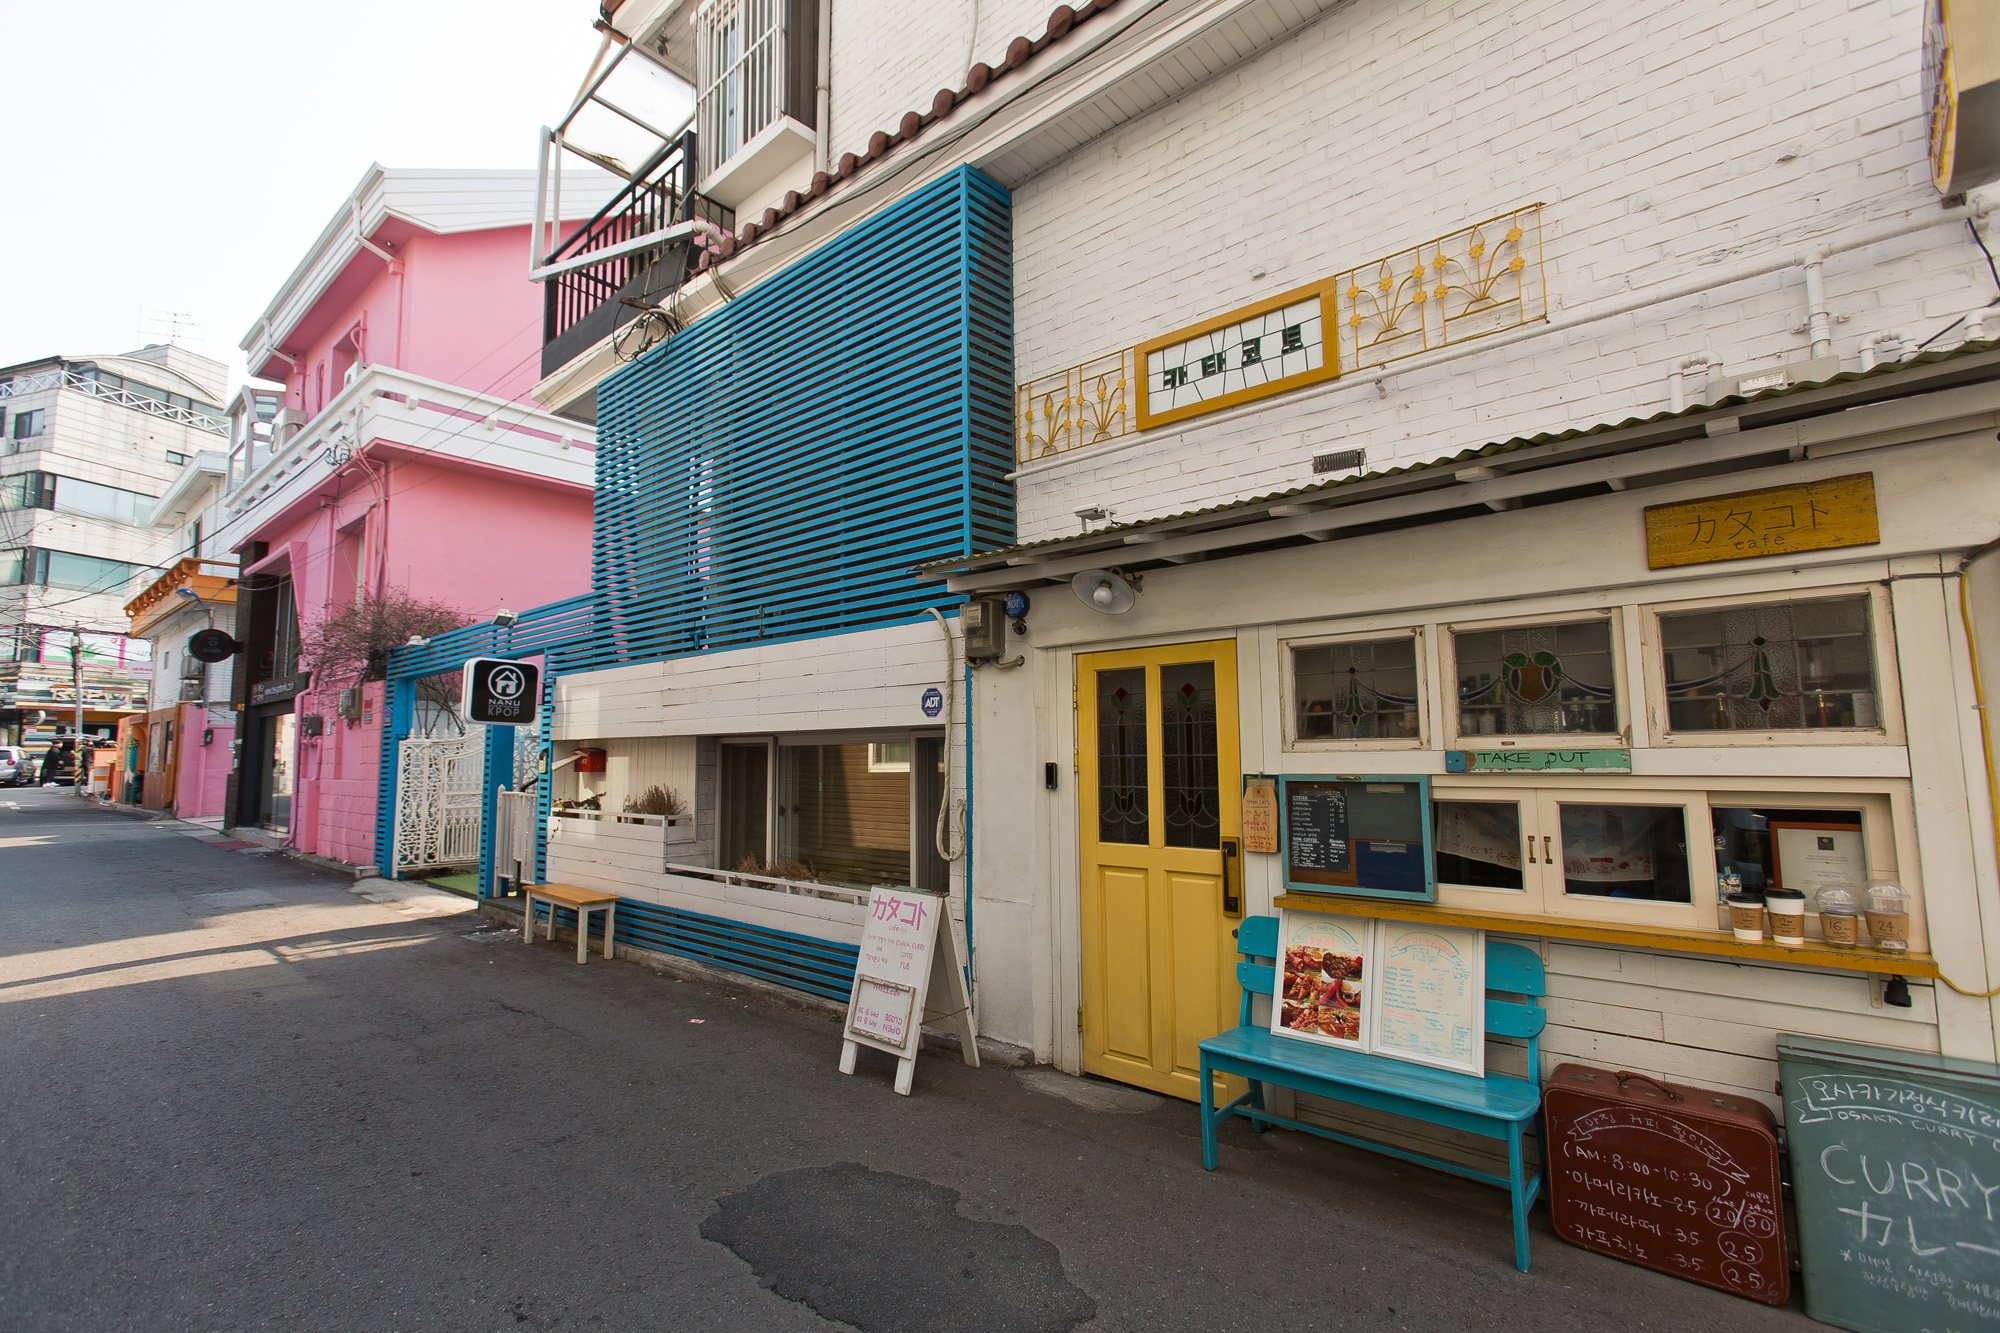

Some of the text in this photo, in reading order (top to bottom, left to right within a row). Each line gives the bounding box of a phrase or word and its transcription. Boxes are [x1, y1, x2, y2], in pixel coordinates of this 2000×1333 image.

[1687, 499, 1829, 545] カタコト
[1735, 533, 1785, 550] cafe
[925, 697, 939, 708] ADT
[488, 707, 520, 716] KPOP
[1477, 751, 1590, 763] TAKE OUT
[872, 894, 927, 931] カタコト
[888, 924, 899, 932] cafe
[1830, 921, 1842, 930] 16
[1878, 920, 1895, 932] 24
[911, 943, 925, 951] CURRY
[900, 961, 910, 970] PUB
[871, 1010, 879, 1018] PM
[885, 1013, 902, 1025] CLOSE
[882, 1024, 901, 1035] OPEN
[1585, 1112, 1616, 1127] 아침
[1629, 1114, 1659, 1129] 커피
[1837, 1110, 1903, 1125] OSAKA
[1912, 1120, 1977, 1146] CURRY
[1821, 1140, 2000, 1220] CURRY
[1572, 1170, 1662, 1208] 아메리카노
[1673, 1196, 1697, 1217] 2.5
[1712, 1207, 1736, 1222] 2.0
[1675, 1228, 1699, 1246] 3.5
[1724, 1241, 1756, 1261] 2.5
[1575, 1225, 1760, 1288] 카푸치노 3.5 2.5
